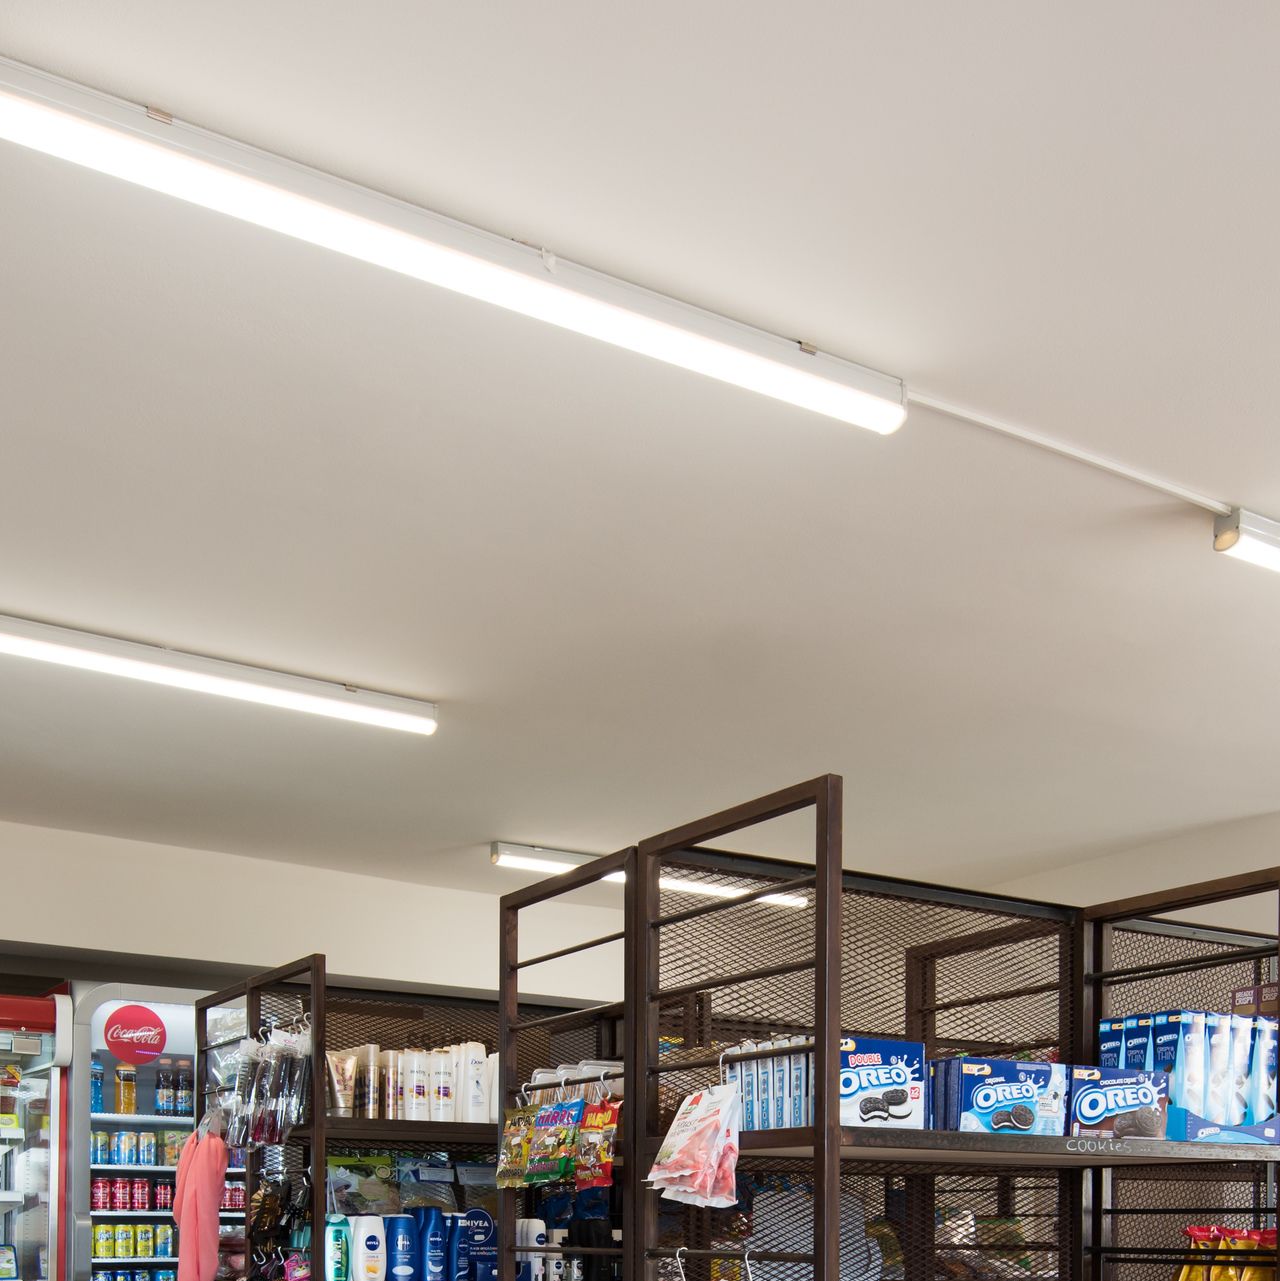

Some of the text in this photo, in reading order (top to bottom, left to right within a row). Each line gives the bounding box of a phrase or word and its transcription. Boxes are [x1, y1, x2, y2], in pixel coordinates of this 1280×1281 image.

[107, 1024, 163, 1044] Coca-Cola
[1156, 1033, 1178, 1043] OREO
[1127, 1037, 1147, 1047] OREO
[849, 1053, 882, 1066] DOUBLE
[1127, 1055, 1144, 1063] THIN
[1157, 1051, 1175, 1060] THIN
[840, 1066, 906, 1096] OREO
[976, 1084, 1034, 1108] OREO
[1081, 1086, 1152, 1119] OREO
